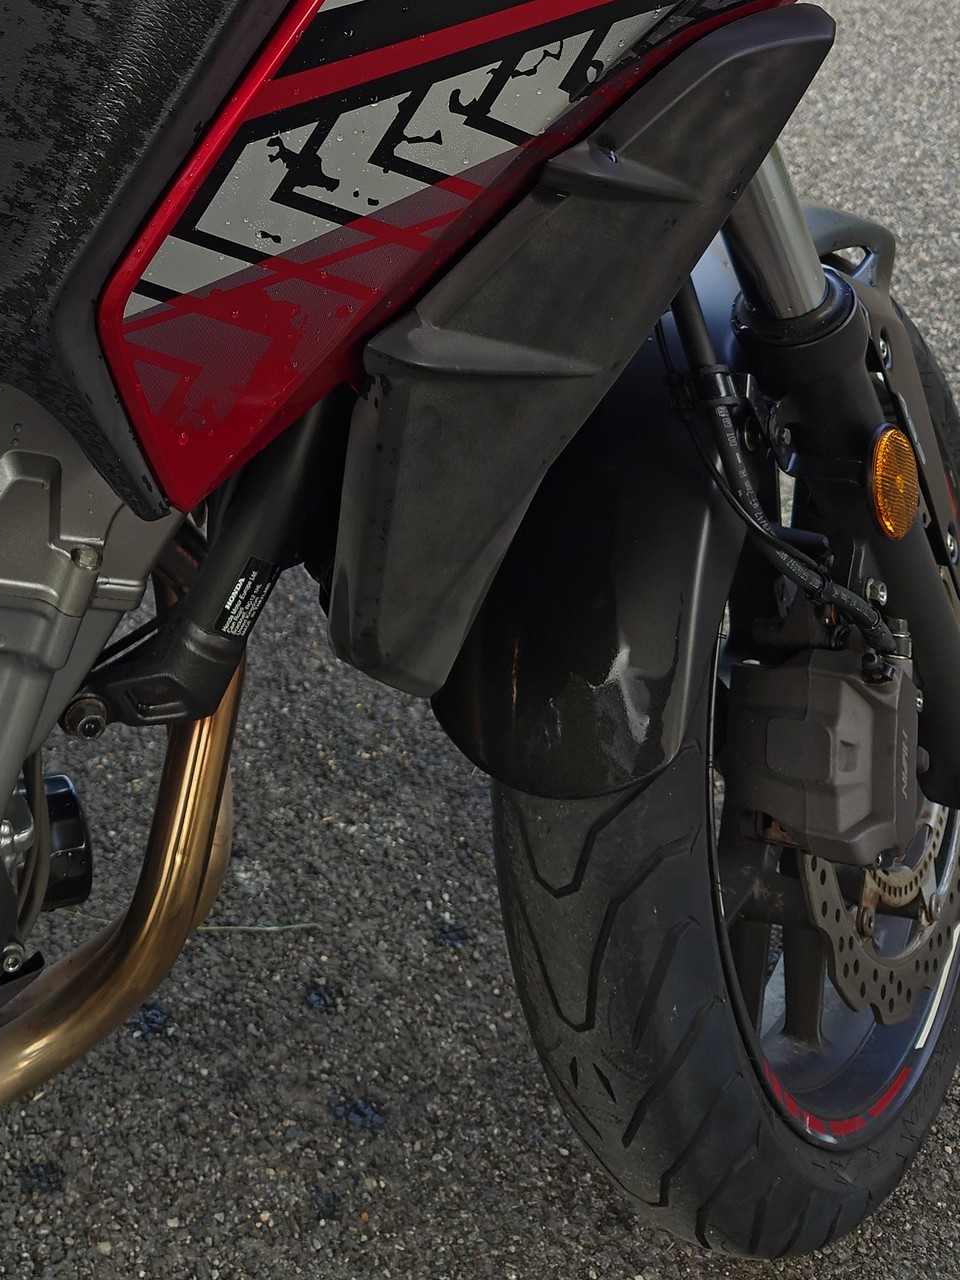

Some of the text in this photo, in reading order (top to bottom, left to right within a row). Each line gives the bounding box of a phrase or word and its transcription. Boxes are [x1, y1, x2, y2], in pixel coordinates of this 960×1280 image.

[221, 614, 234, 632] Honda
[231, 599, 242, 615] Motor
[239, 580, 253, 600] Europe
[225, 577, 246, 610] HONDA
